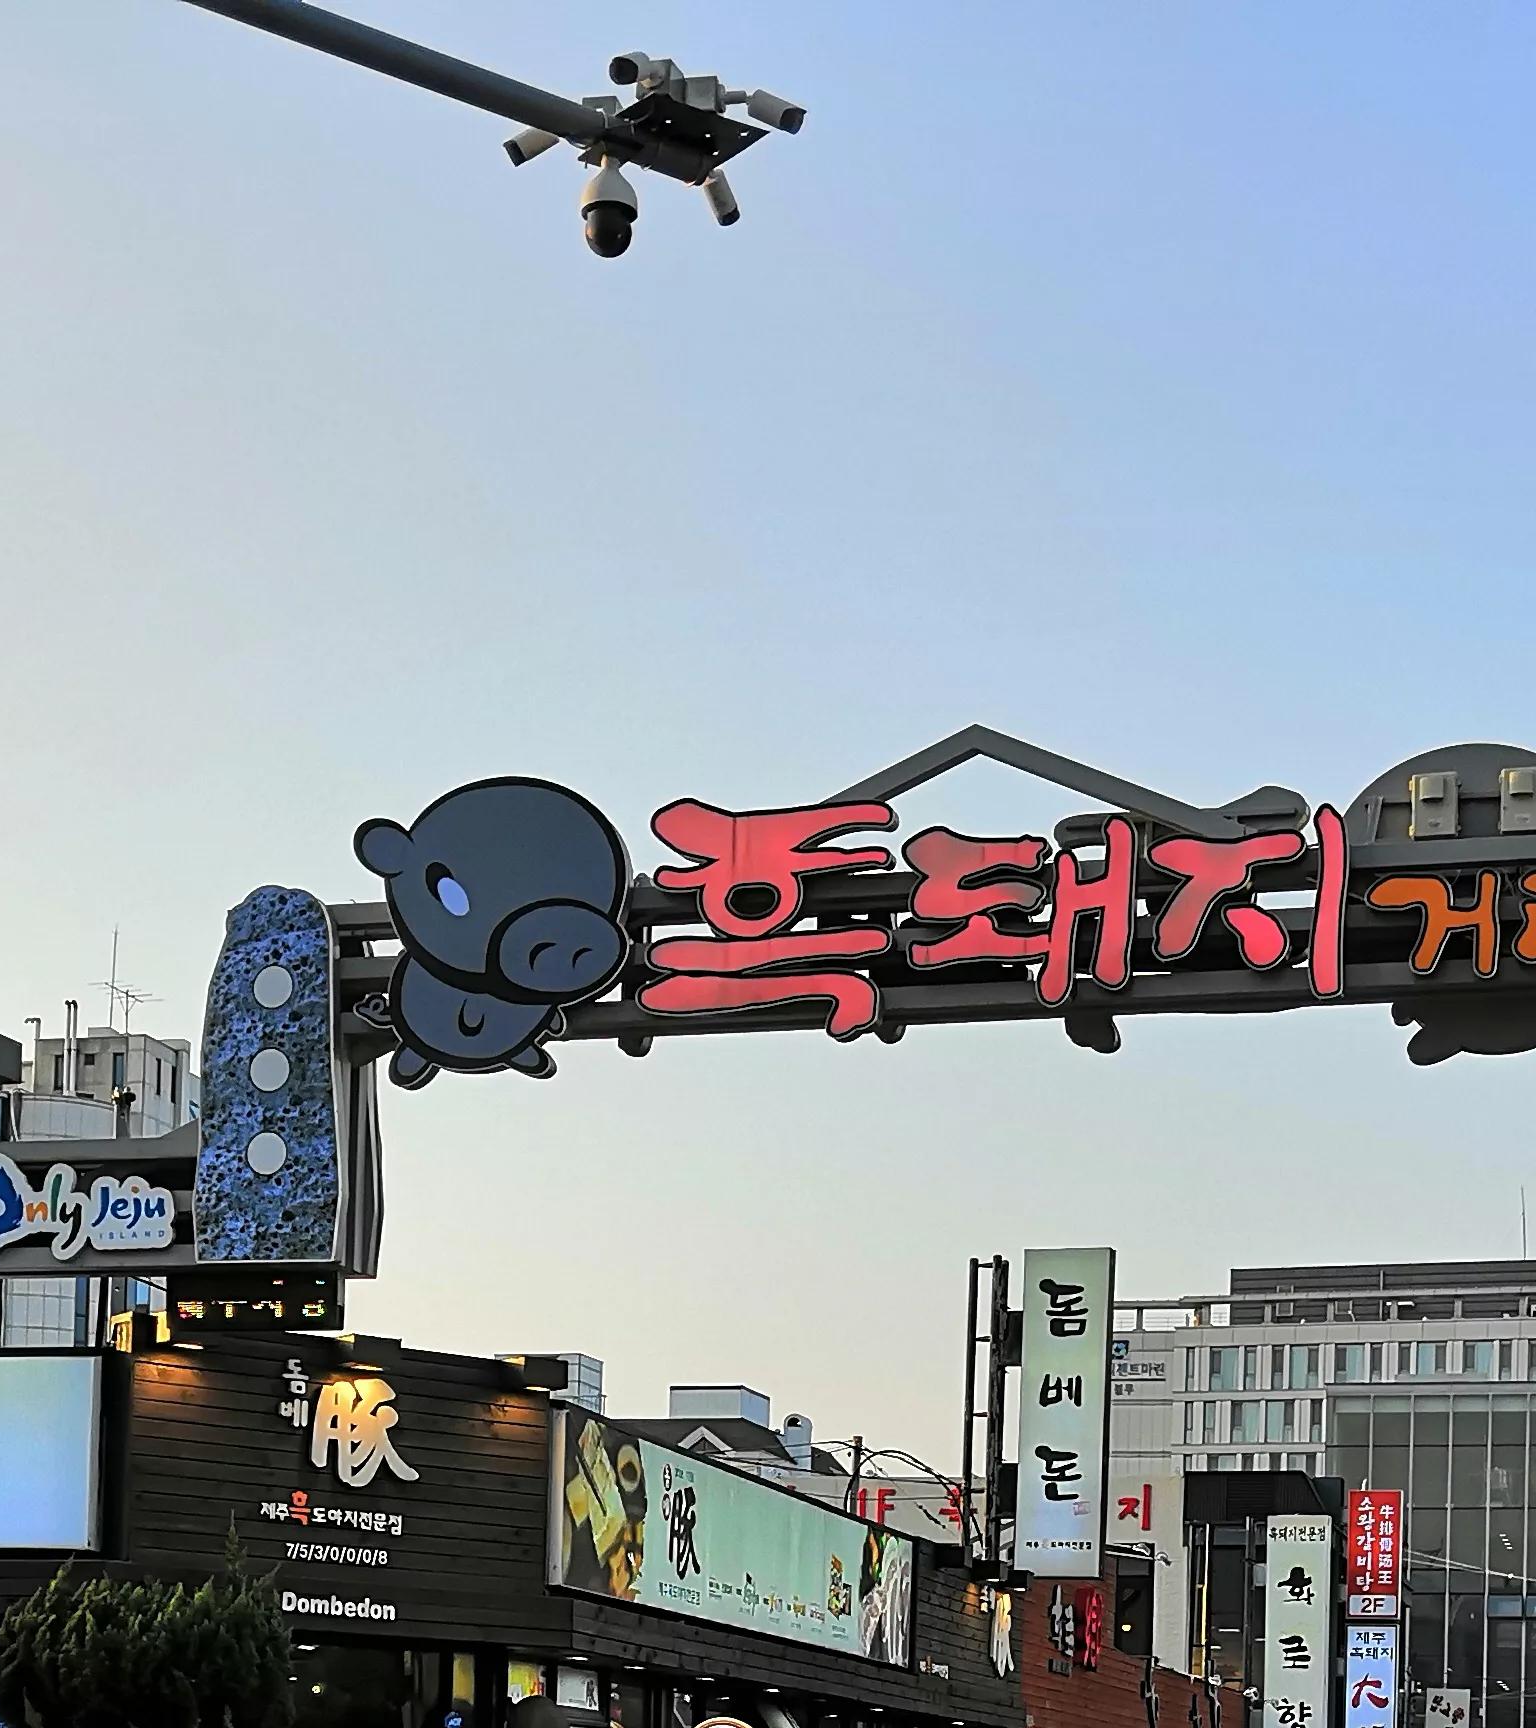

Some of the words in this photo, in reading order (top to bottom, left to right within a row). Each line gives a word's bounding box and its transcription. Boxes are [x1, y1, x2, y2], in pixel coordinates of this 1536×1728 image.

[637, 798, 1348, 1040] 흑돼지
[91, 1186, 166, 1228] Jeju
[98, 1230, 166, 1241] ISLAND
[279, 1359, 310, 1428] 돔베
[1034, 1278, 1089, 1502] 돔베돈
[285, 1542, 388, 1566] 7/5/3/0/0/0/8
[281, 1591, 396, 1621] Dombedon
[1360, 1597, 1386, 1614] 2F
[1355, 1631, 1387, 1645] 제주
[1349, 1647, 1394, 1660] 흑돼지
